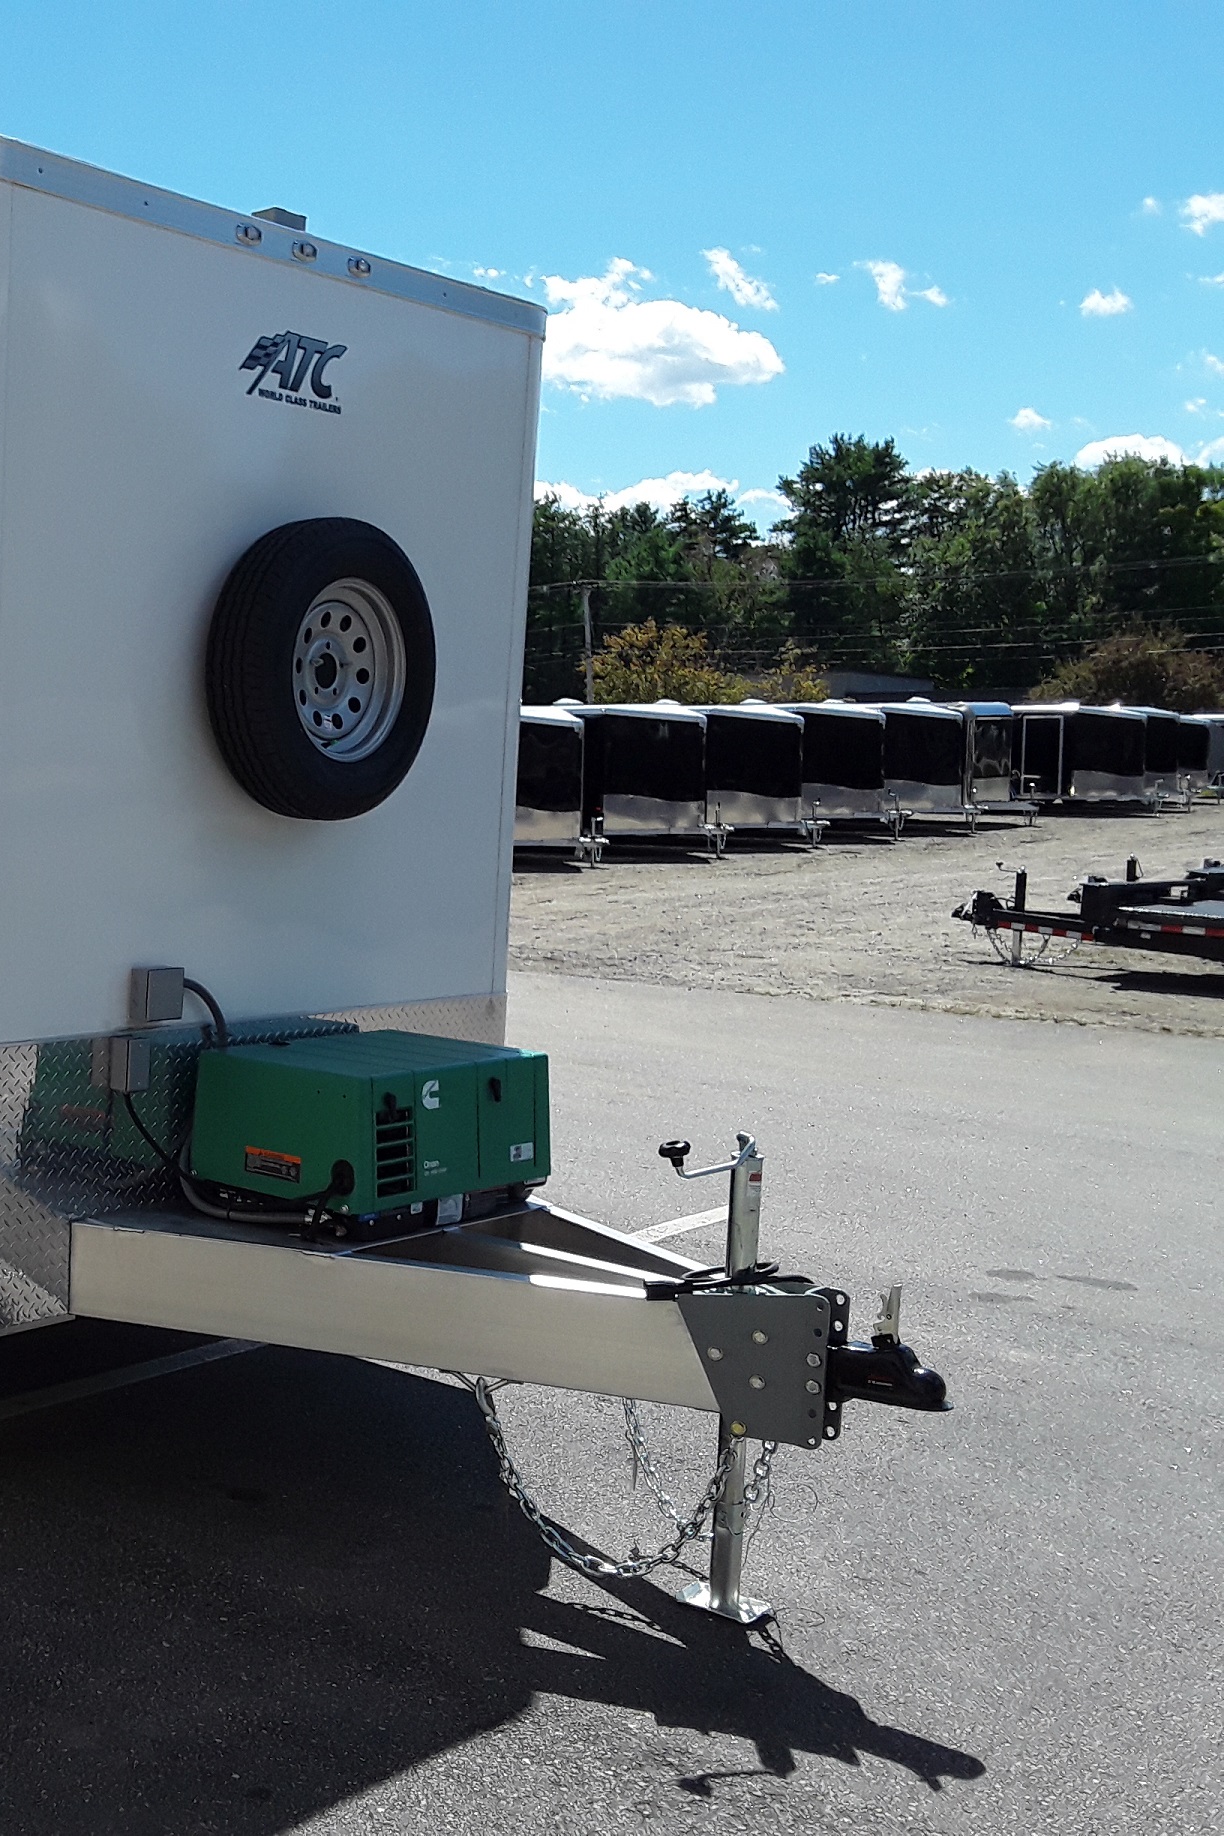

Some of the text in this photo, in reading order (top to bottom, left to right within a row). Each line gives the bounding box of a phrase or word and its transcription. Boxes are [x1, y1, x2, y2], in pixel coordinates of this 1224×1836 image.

[246, 331, 348, 399] ATC
[258, 387, 341, 414] WORLD CLASS TRAILERS
